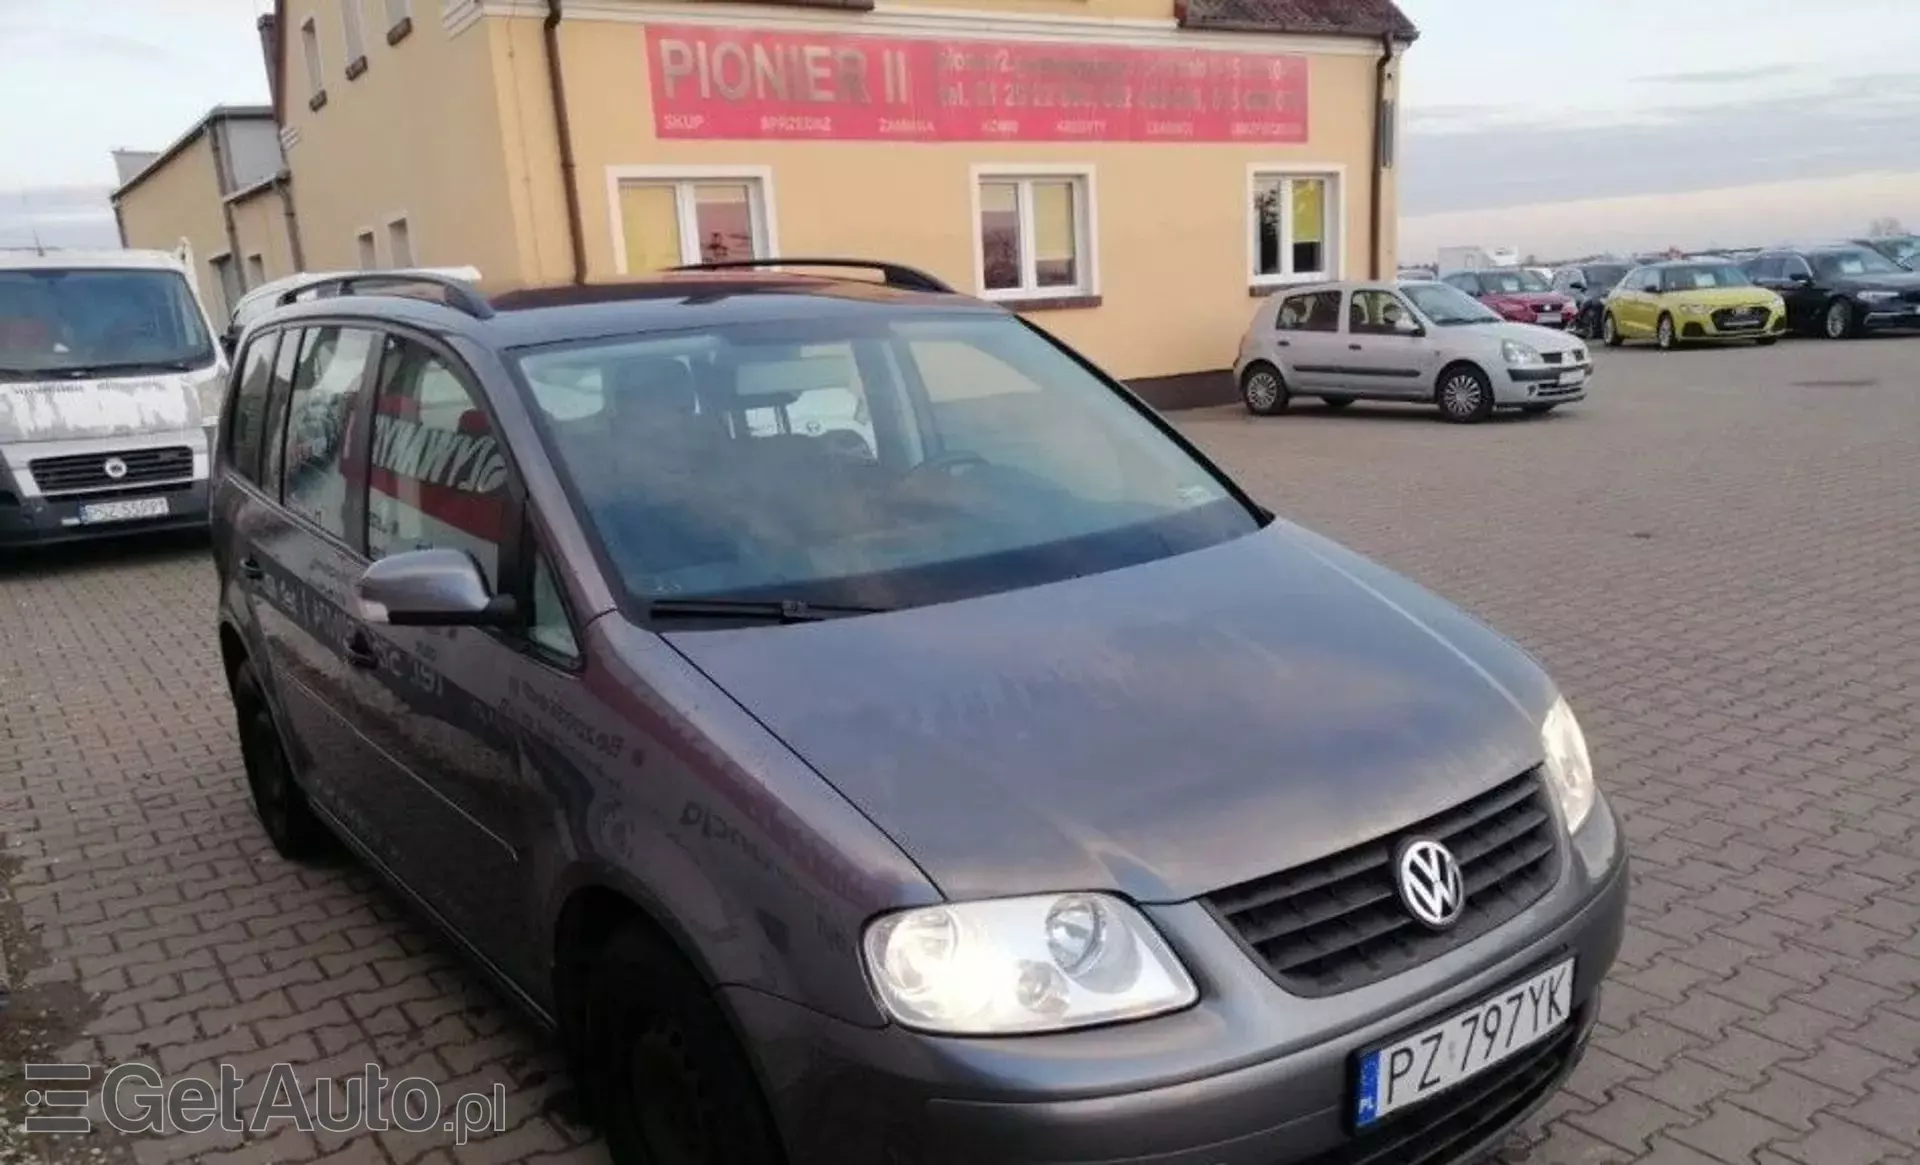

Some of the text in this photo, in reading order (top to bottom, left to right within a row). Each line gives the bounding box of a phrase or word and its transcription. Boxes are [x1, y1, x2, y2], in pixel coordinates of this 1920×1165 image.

[659, 38, 871, 103] PIONIER
[1387, 966, 1567, 1104] PZ 797YK
